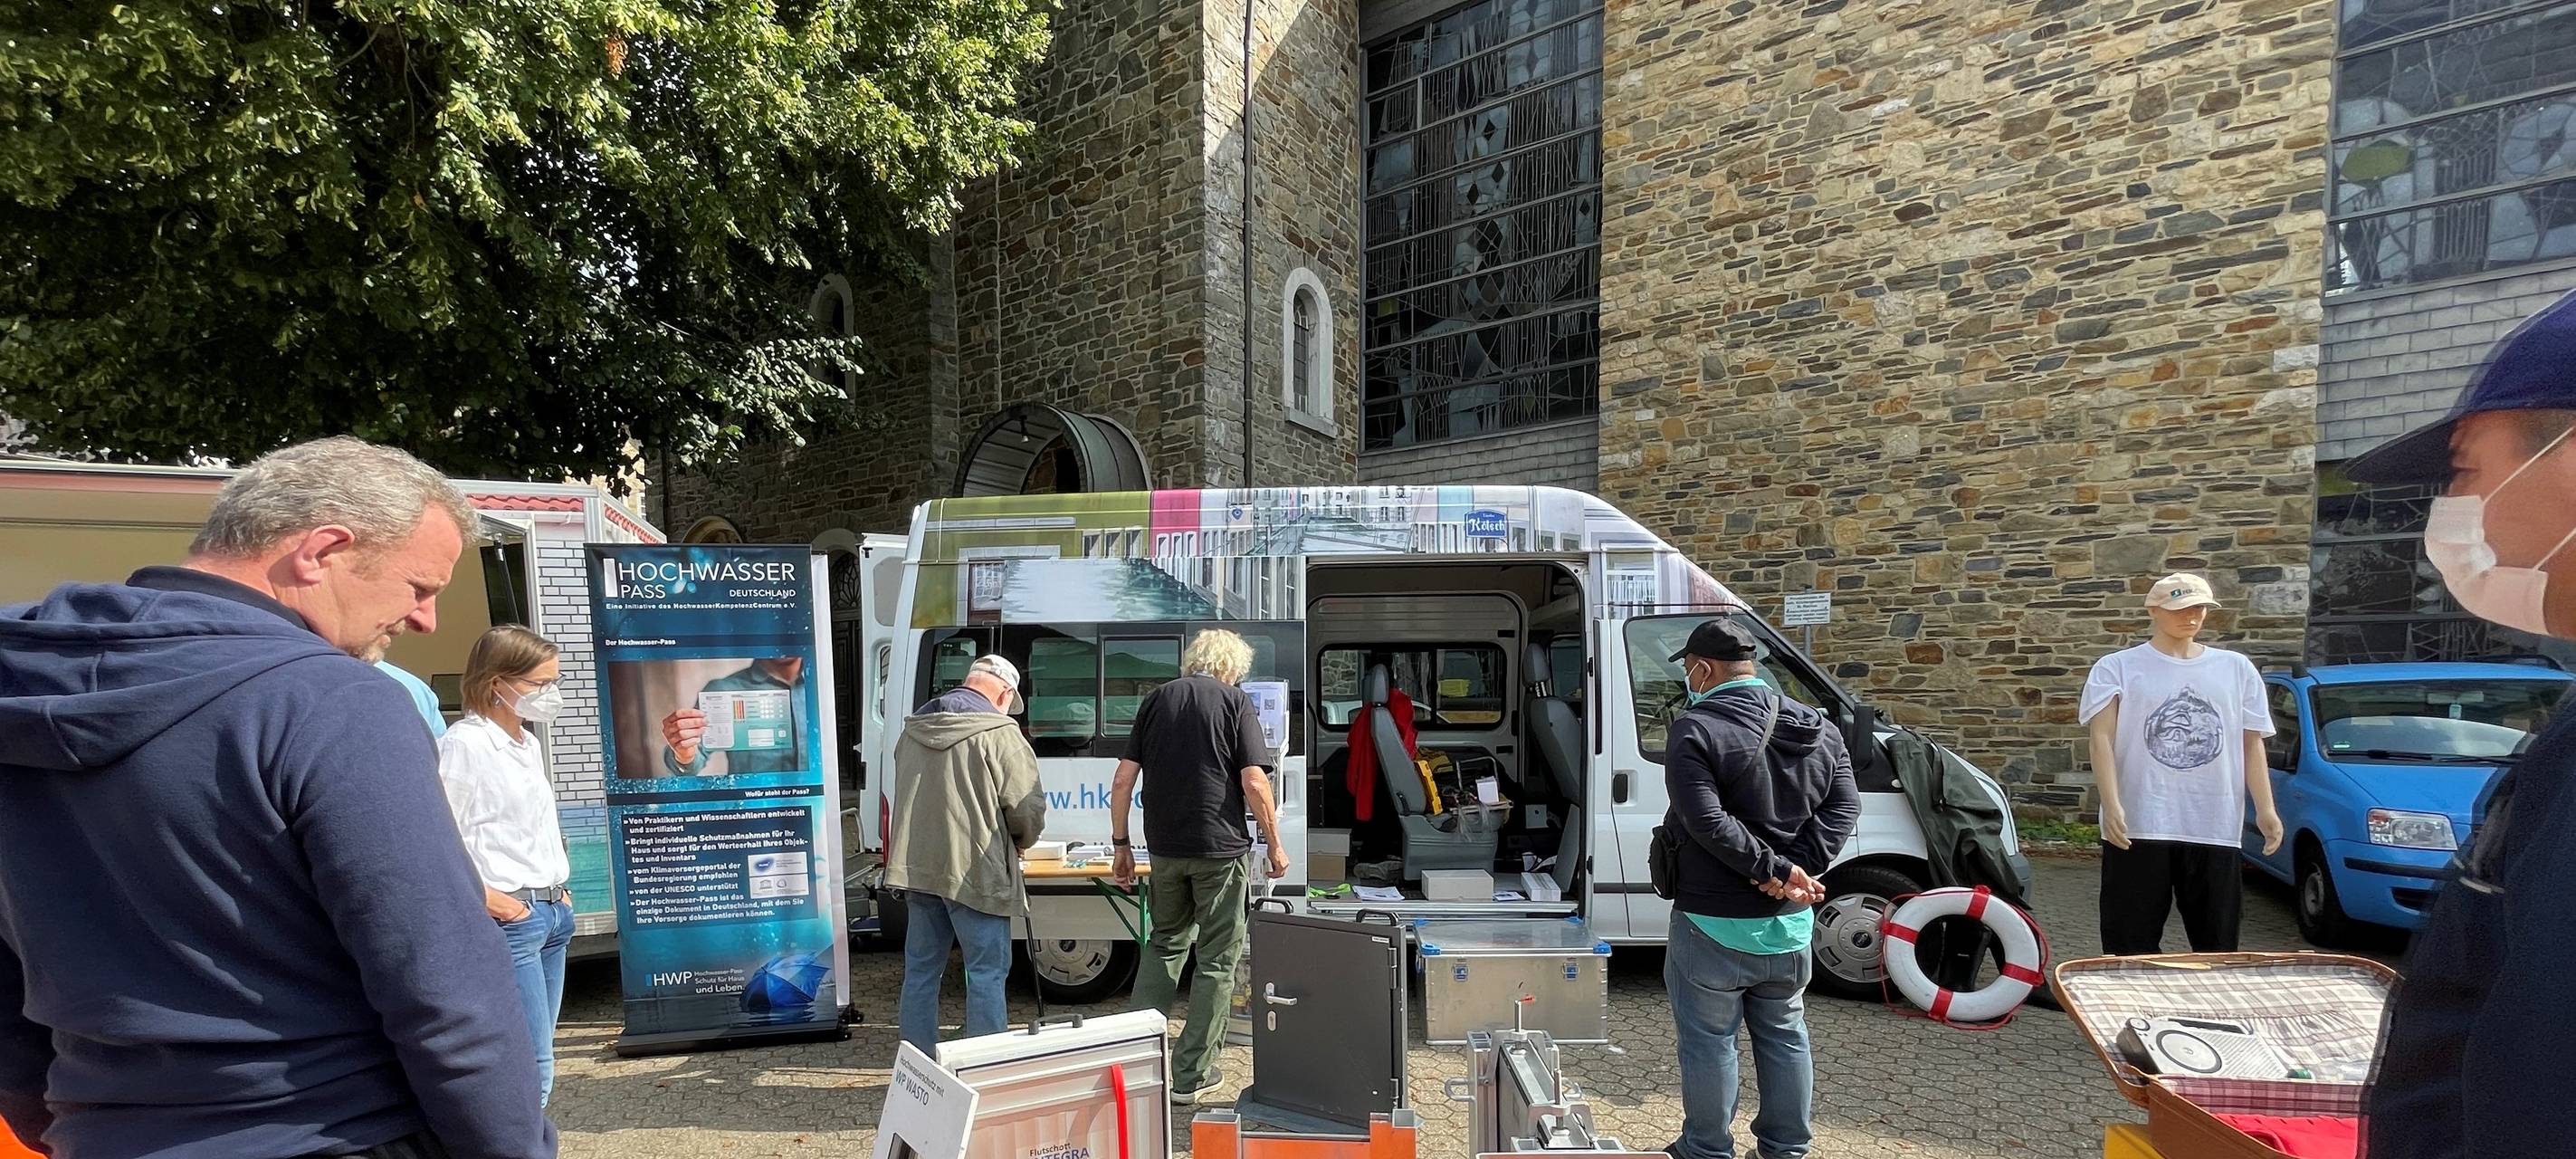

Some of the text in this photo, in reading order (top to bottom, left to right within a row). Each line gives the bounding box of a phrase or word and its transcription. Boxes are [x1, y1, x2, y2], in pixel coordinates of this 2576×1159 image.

[618, 562, 796, 581] HOCHWASSER
[621, 584, 796, 599] PASS DEUTSCHLAND
[644, 816, 684, 824] Praktikern
[685, 814, 700, 822] und
[701, 811, 767, 821] Wissenschaftlern
[768, 809, 806, 818] entwickelt
[629, 825, 684, 834] und zertifiziert
[630, 838, 654, 846] Bringt
[699, 832, 770, 842] Schutzmaßnahmen
[667, 845, 687, 853] sorgt
[702, 843, 717, 851] den
[718, 840, 762, 850] Werteerhalt
[763, 839, 783, 848] Ihres
[784, 838, 808, 847] Objek-
[632, 854, 697, 864] tes und Inventars
[633, 867, 649, 875] vom
[651, 863, 727, 874] Klimavorsorgeportal
[634, 871, 739, 884] Bundesregierung empfohlen
[664, 885, 696, 893] UNESCO
[697, 883, 739, 892] unterstützt
[635, 898, 650, 906] Der
[651, 895, 719, 905] Hochwasser-Pass
[635, 906, 663, 915] einzige
[664, 905, 701, 914] Dokument
[712, 901, 759, 911] Deutschland,
[761, 899, 774, 907] mit
[775, 898, 791, 906] dem
[792, 897, 805, 905] Sie
[636, 909, 776, 924] Ihre Vorsorge dokumentieren können.
[654, 971, 692, 987] HWP
[695, 976, 717, 984] Schutz
[718, 975, 728, 983] für
[696, 985, 713, 994] und
[896, 1069, 929, 1106] WP WASTO
[1029, 1143, 1071, 1157] Flutschott
